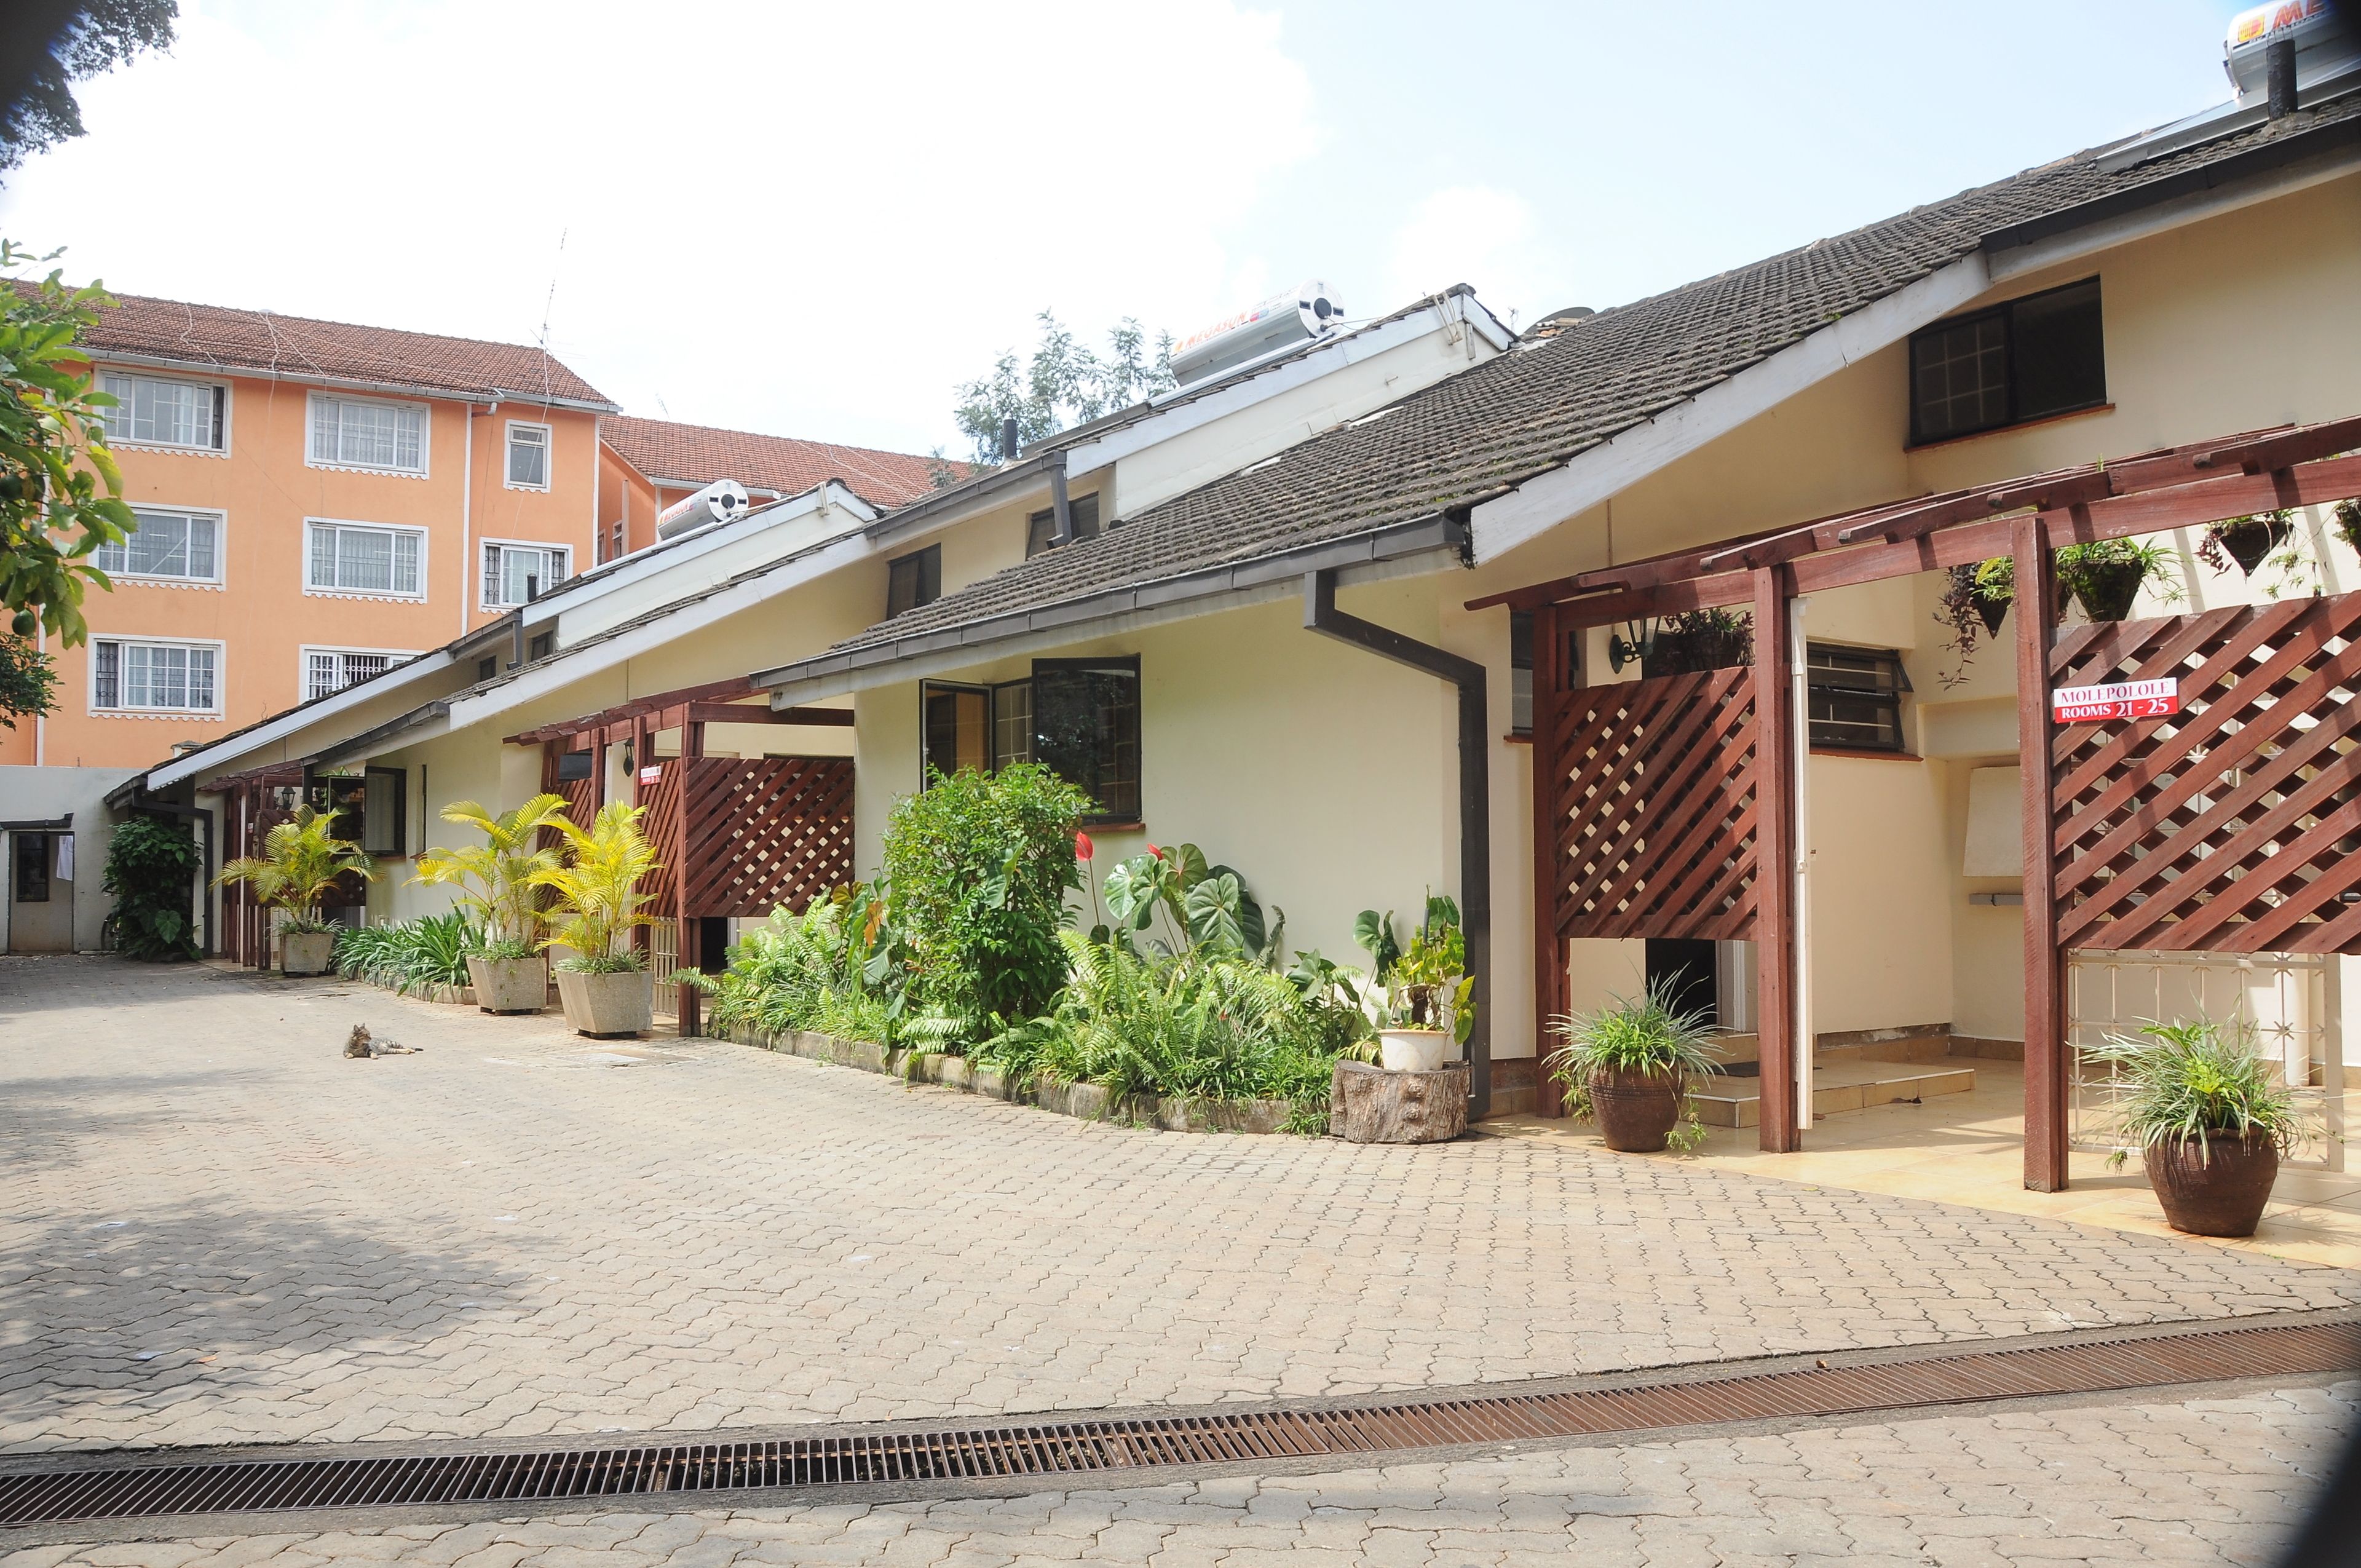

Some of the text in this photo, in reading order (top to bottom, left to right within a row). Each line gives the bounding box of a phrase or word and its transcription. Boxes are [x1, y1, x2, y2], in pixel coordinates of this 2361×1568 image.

[1185, 310, 1249, 347] MEGASUN
[2061, 681, 2170, 704] MOLEPOLOLE
[2061, 703, 2111, 719] ROOMS
[2116, 702, 2134, 716] 21
[2147, 698, 2169, 714] 25
